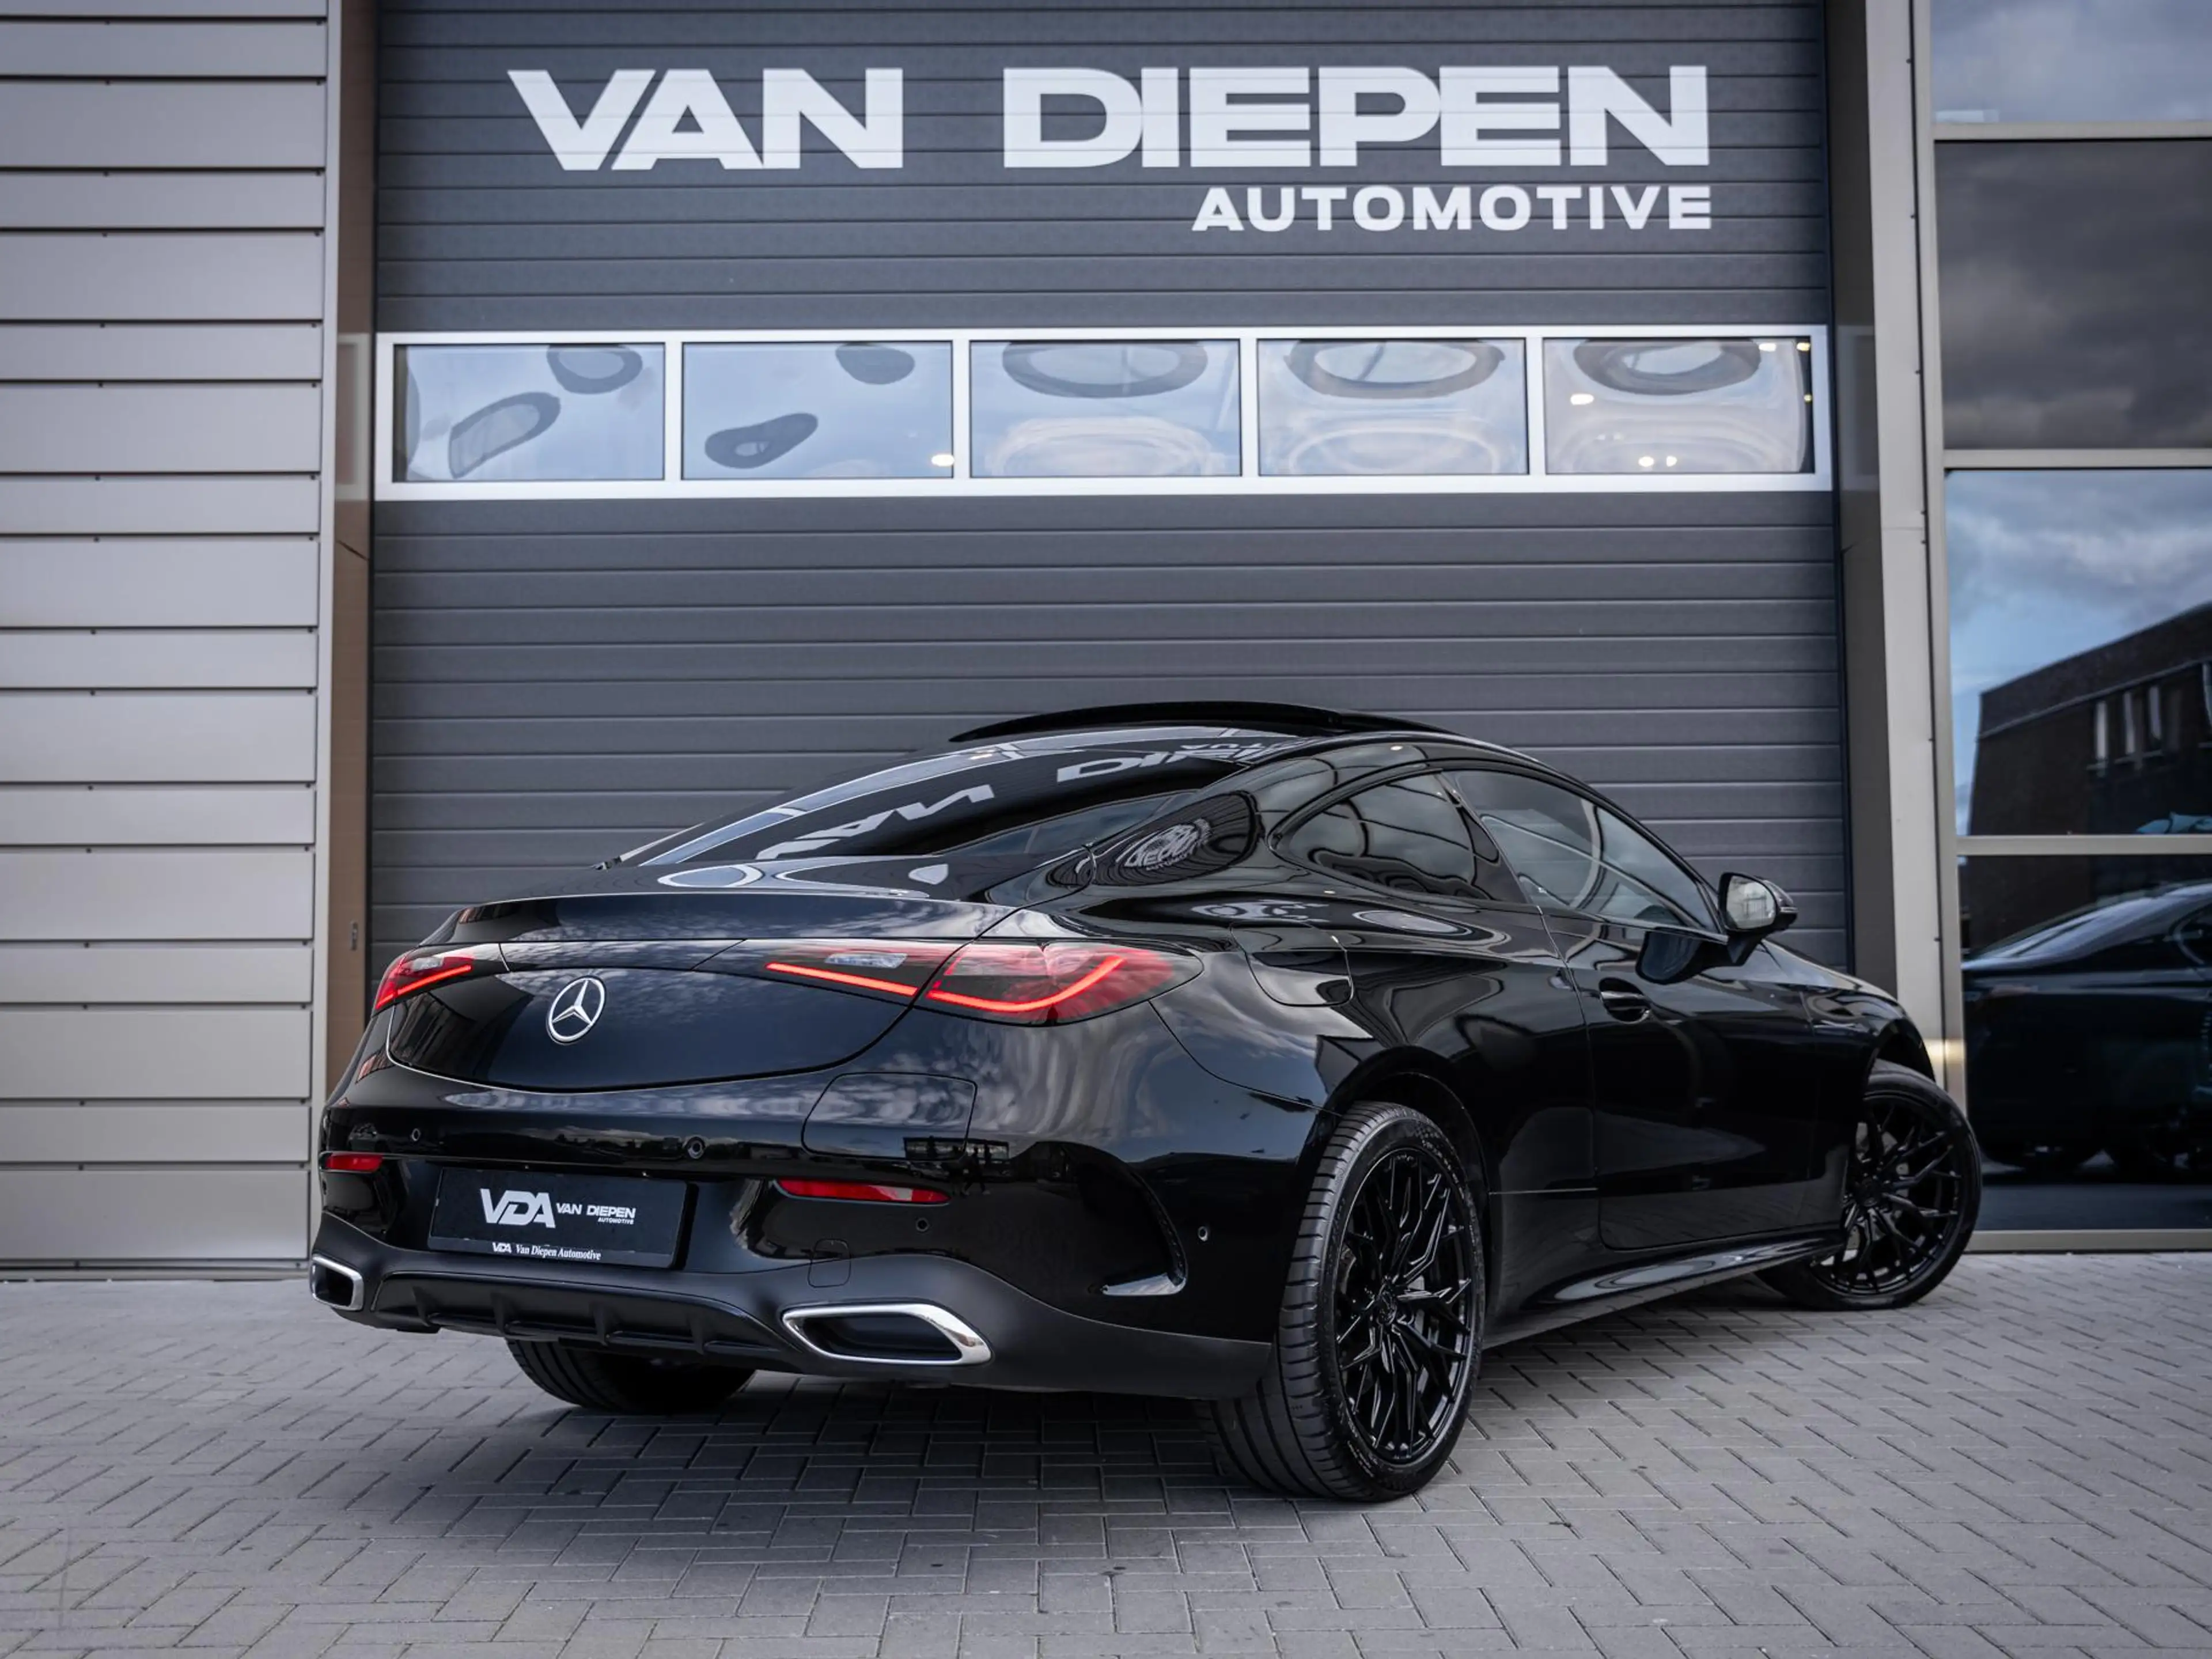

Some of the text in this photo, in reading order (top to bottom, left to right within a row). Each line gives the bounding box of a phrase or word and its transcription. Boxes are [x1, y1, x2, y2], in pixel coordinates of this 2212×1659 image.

[507, 65, 1710, 171] VAN DIEPEN
[1192, 185, 1711, 232] AUTOMOTIVE
[480, 1188, 556, 1228] VDA
[556, 1203, 636, 1218] VAN DIEPEN
[492, 1242, 601, 1260] VDA Van Diepen Automotive
